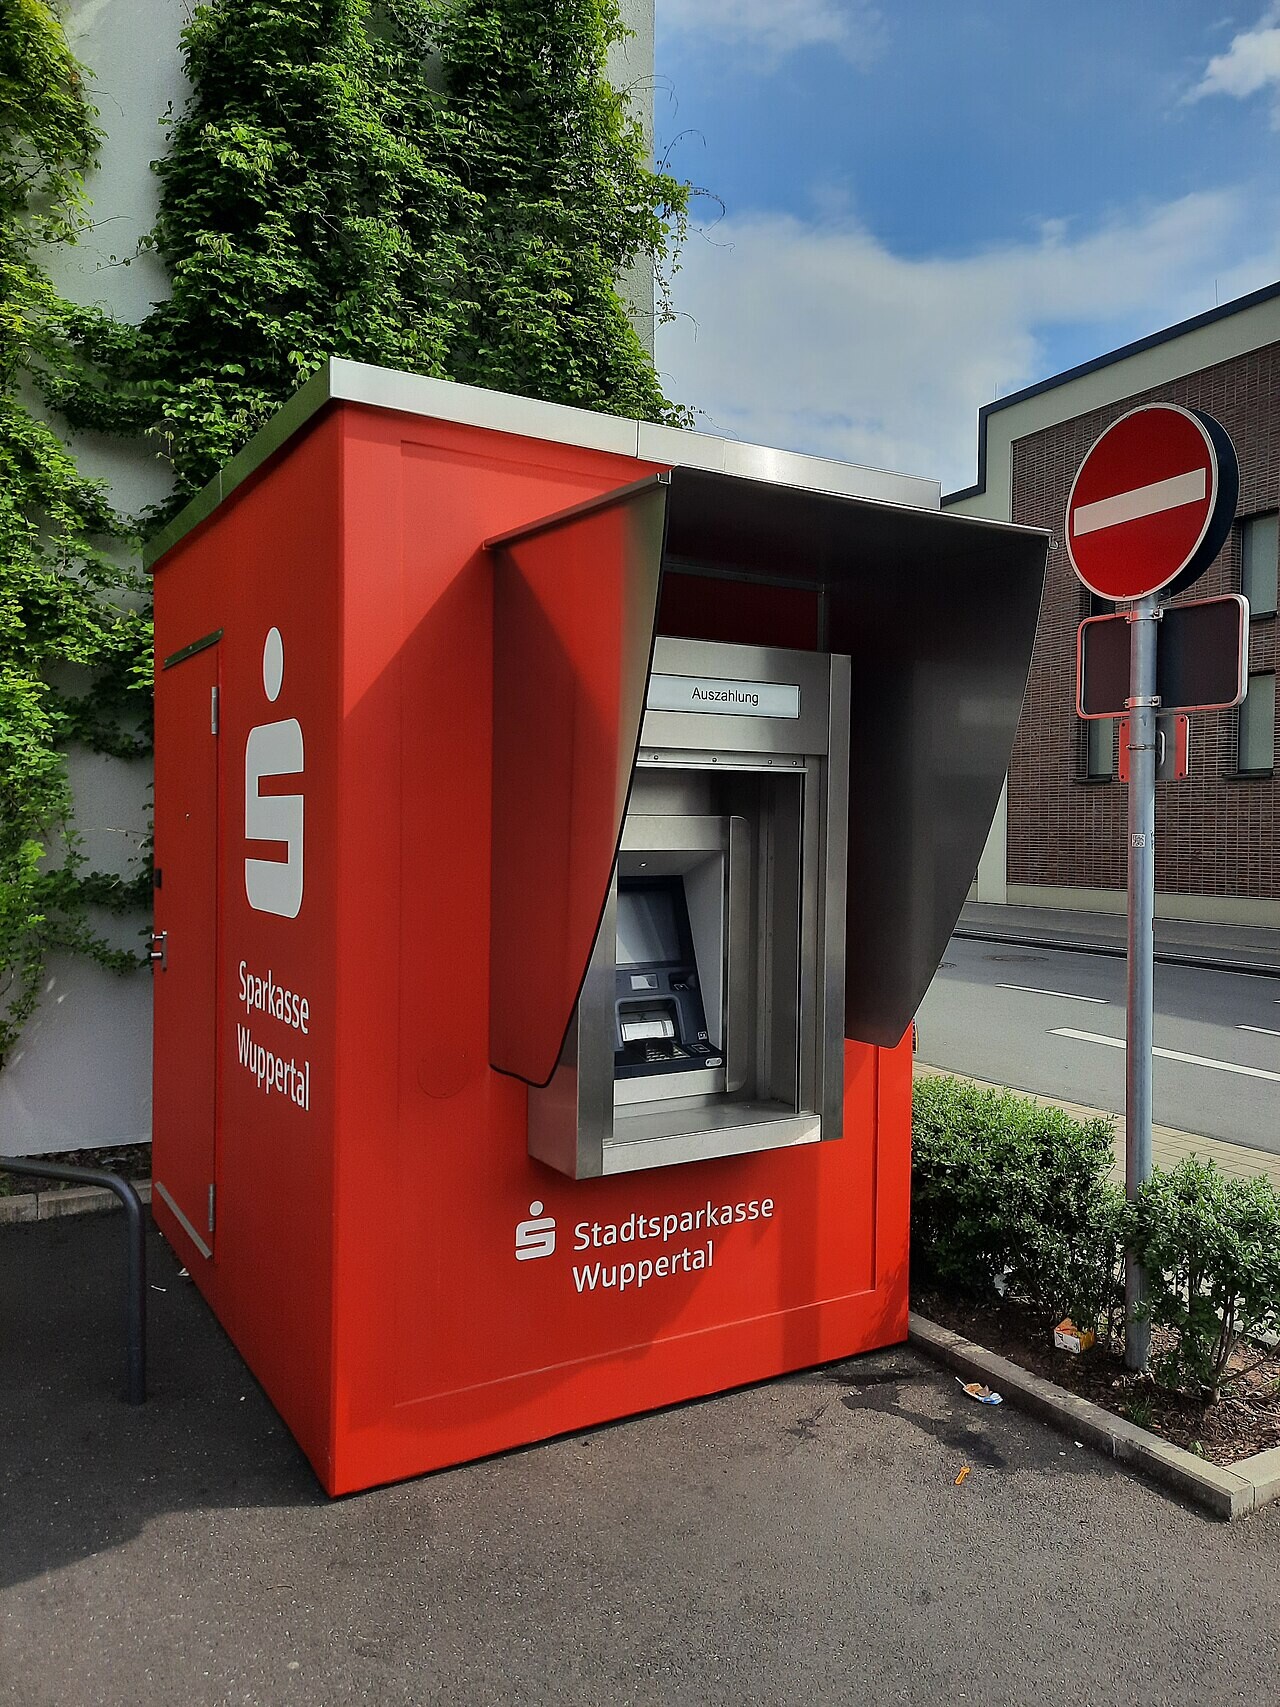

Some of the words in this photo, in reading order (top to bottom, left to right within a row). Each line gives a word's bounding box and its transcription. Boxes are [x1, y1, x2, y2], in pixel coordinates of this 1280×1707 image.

[691, 687, 759, 707] Auszahlung
[238, 960, 309, 1035] Sparkasse
[237, 1022, 310, 1112] Wuppertal
[573, 1198, 774, 1251] Stadtsparkasse
[572, 1239, 714, 1293] Wuppertal
